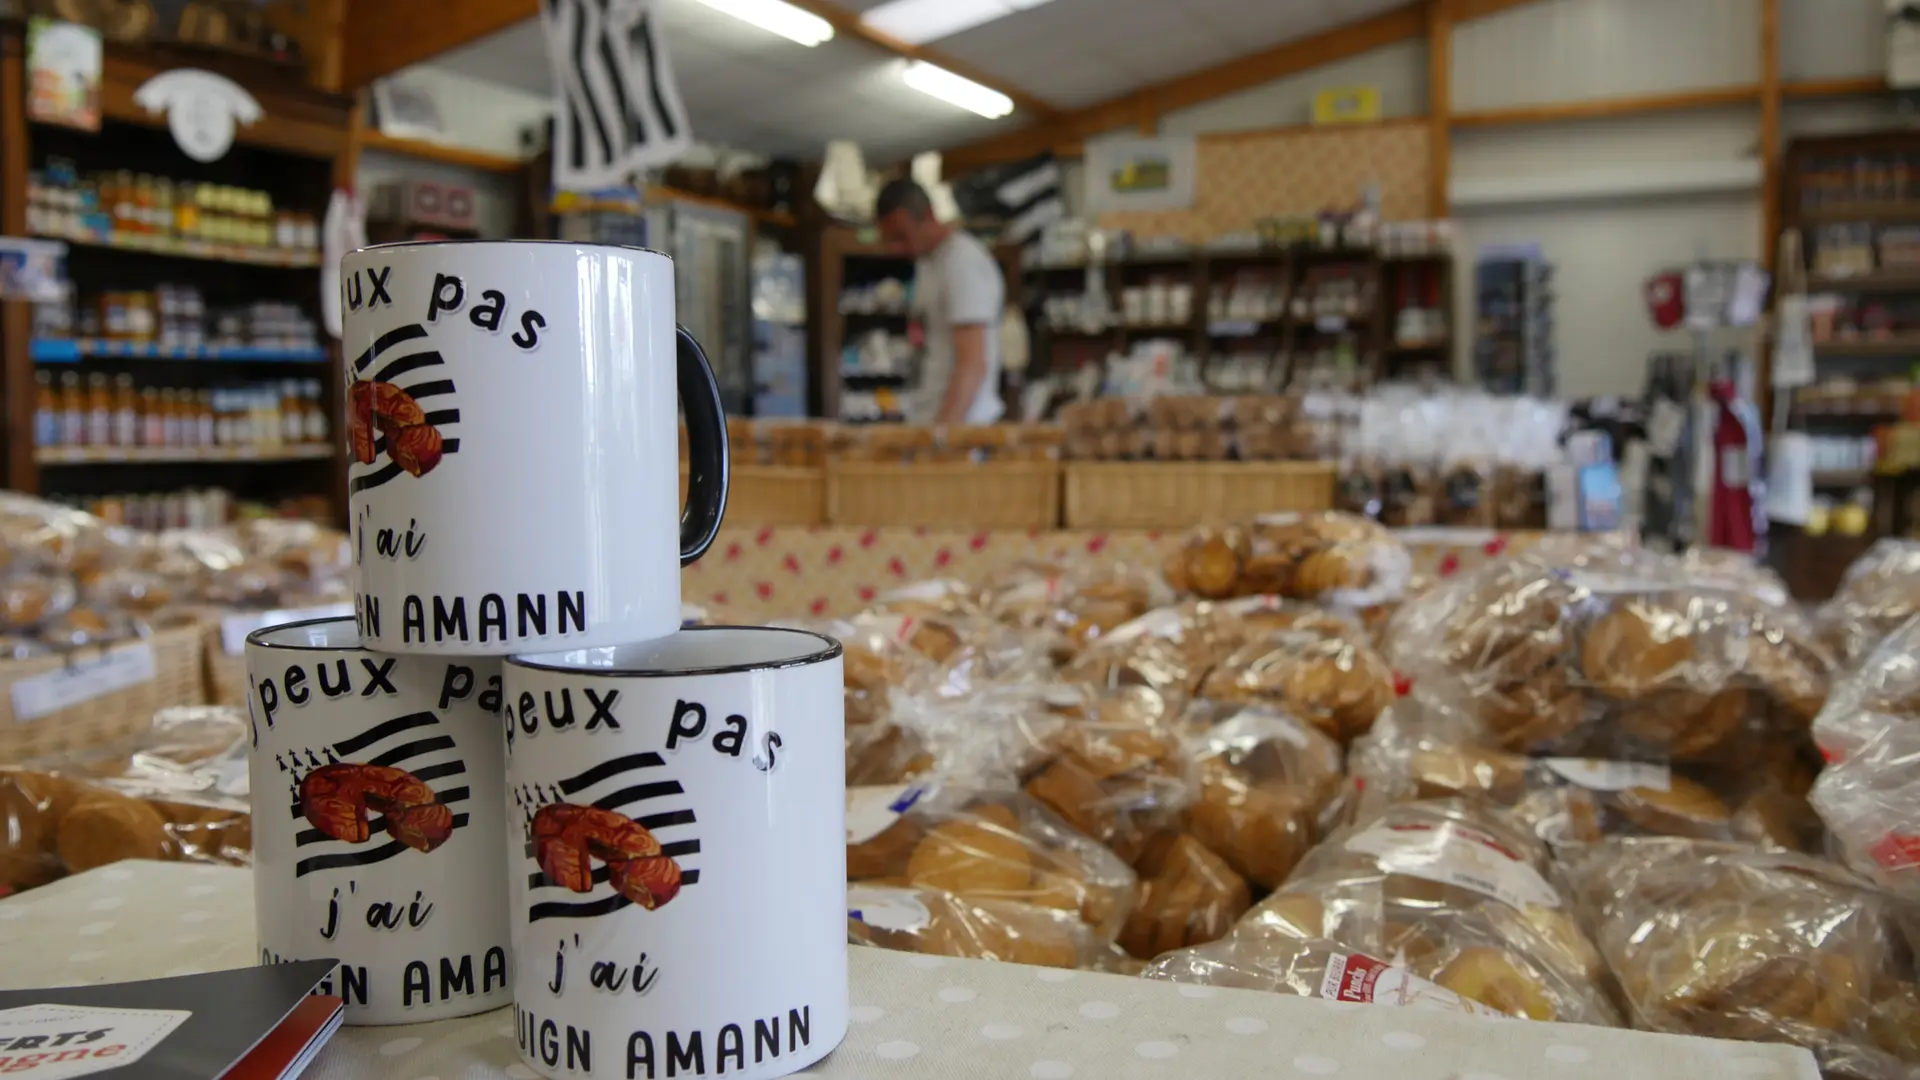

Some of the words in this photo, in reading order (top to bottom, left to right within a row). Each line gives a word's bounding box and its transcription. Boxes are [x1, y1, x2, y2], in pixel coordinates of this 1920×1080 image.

[341, 266, 392, 323] ux
[427, 273, 546, 349] pas
[356, 505, 426, 566] j'ai
[403, 590, 586, 643] AMANN
[665, 699, 782, 771] pas
[320, 880, 434, 939] j'ai
[403, 946, 507, 1007] AMA
[548, 933, 659, 994] j'ai
[625, 1005, 810, 1080] AMANN
